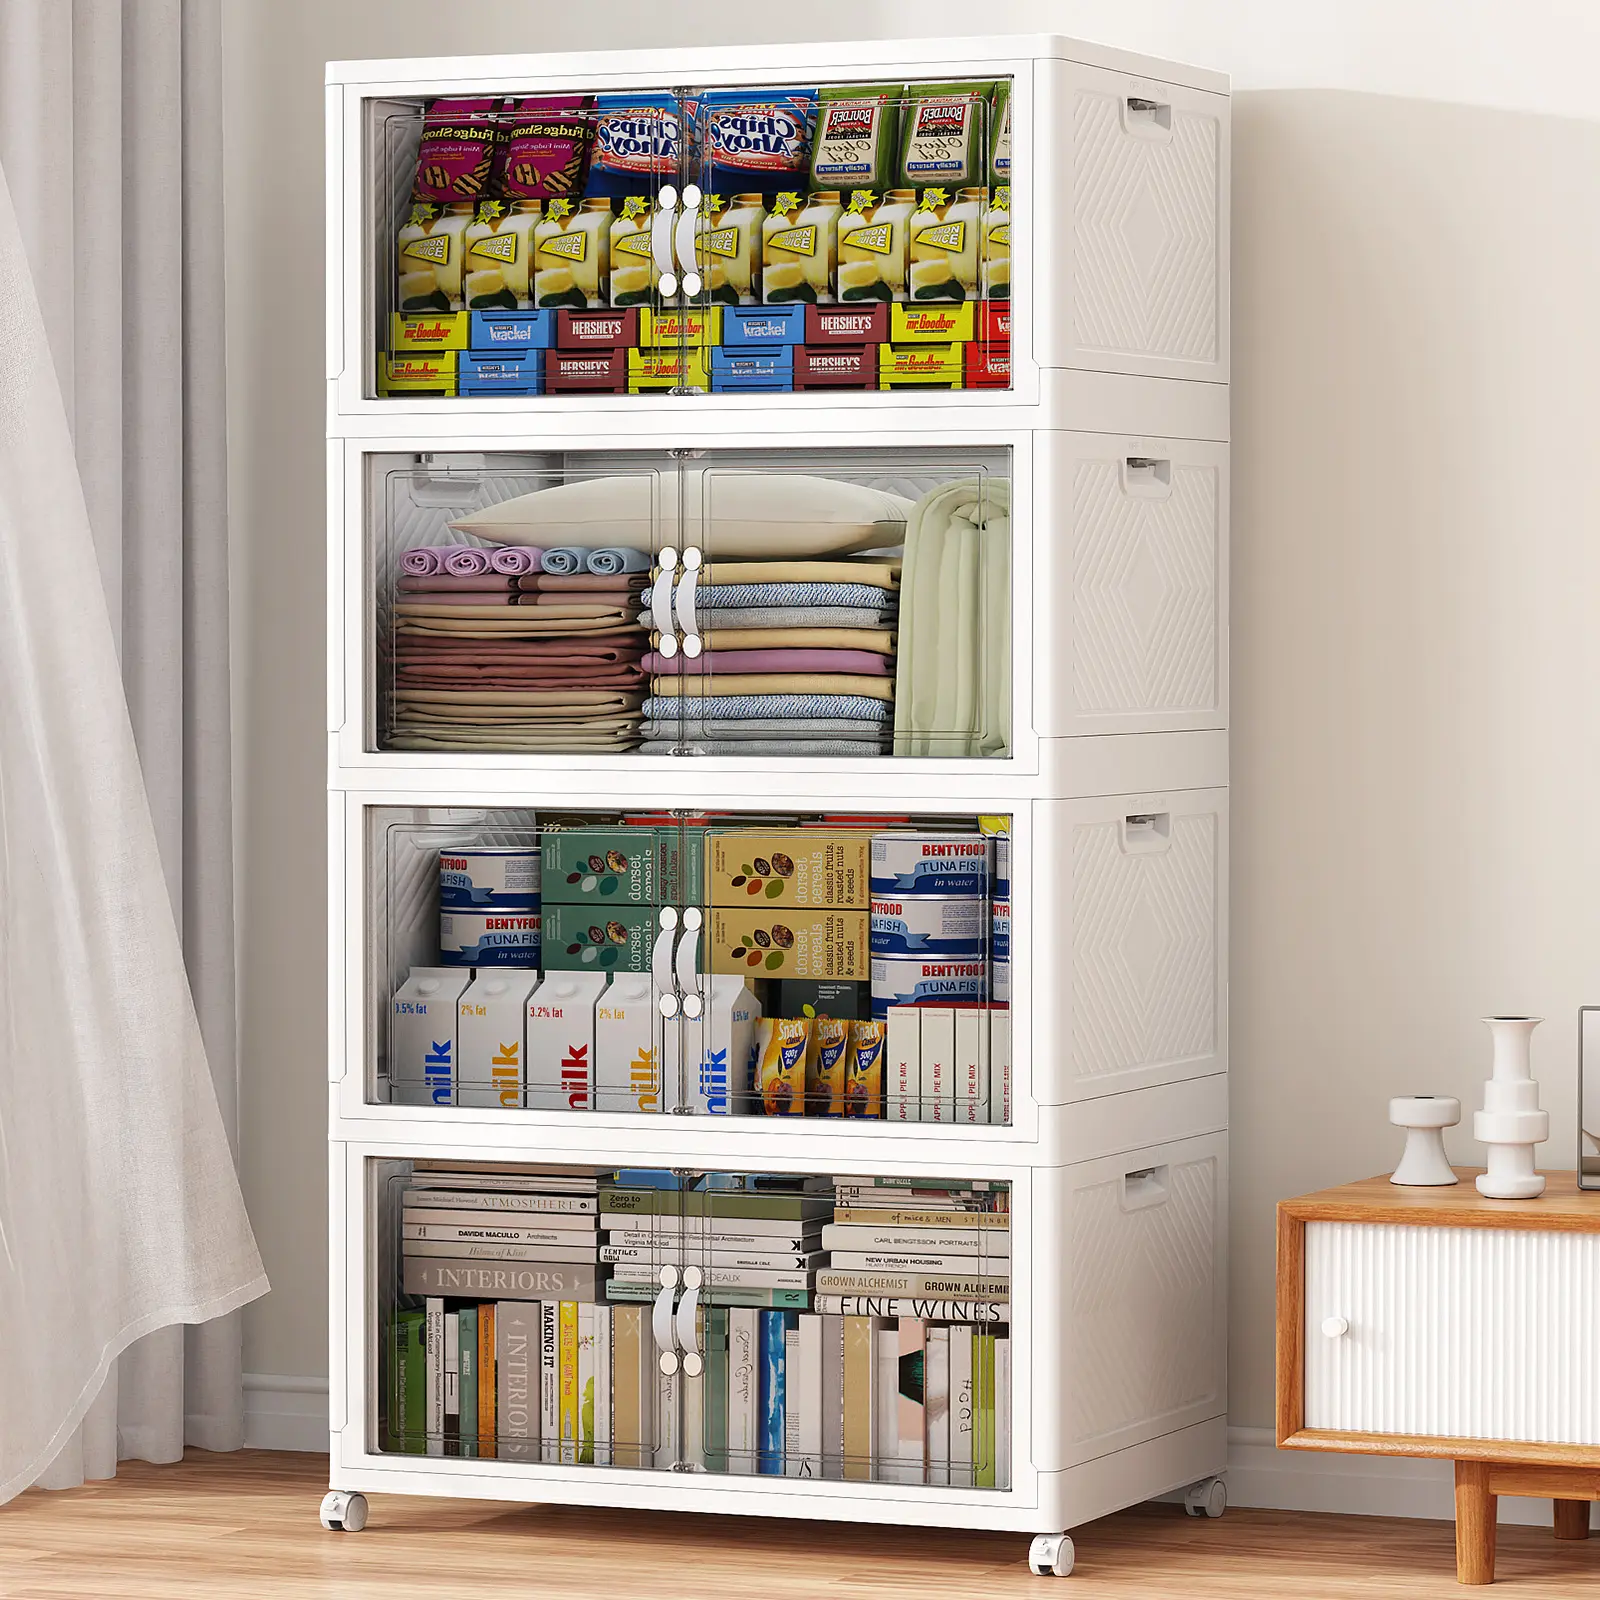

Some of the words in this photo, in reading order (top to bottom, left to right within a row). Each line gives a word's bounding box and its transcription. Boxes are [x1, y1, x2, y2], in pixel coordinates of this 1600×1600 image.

[856, 235, 887, 247] JUICE
[929, 233, 959, 246] JUICE
[552, 243, 581, 255] JUICE
[572, 321, 622, 335] HERSHEY'S
[743, 320, 786, 337] krackel
[820, 316, 872, 331] HERSHEY'S
[906, 320, 919, 330] mr.
[919, 313, 956, 329] Goodbar
[416, 322, 451, 339] Goodbar
[489, 325, 532, 341] krackel
[825, 842, 835, 872] fruits,
[836, 845, 844, 869] nuts
[919, 861, 957, 873] TUNA
[628, 854, 642, 901] dorset
[795, 857, 808, 904] dorset
[809, 852, 823, 904] cereals
[846, 868, 855, 895] seeds
[934, 878, 945, 887] in
[947, 879, 975, 887] water
[825, 873, 834, 904] classic
[835, 871, 844, 904] roasted
[485, 917, 541, 930] BENTYFOO
[825, 914, 835, 944] fruits,
[836, 917, 844, 941] nuts
[879, 920, 900, 932] FISH
[484, 935, 520, 946] TUNA
[521, 934, 541, 945] FIS
[497, 951, 508, 959] in
[510, 951, 537, 959] water
[628, 925, 642, 972] dorset
[795, 929, 808, 976] dorset
[809, 923, 823, 976] cereals
[846, 940, 855, 967] seeds
[825, 945, 834, 976] classic
[835, 943, 844, 976] roasted
[919, 981, 957, 993] TUNA
[415, 1003, 427, 1015] fat
[461, 1004, 474, 1016] 2%
[475, 1005, 487, 1016] fat
[529, 1006, 550, 1018] 3.2%
[552, 1007, 563, 1018] fat
[599, 1008, 612, 1019] 2%
[613, 1008, 625, 1020] fat
[778, 1020, 805, 1040] Snack
[818, 1020, 844, 1041] Snack
[854, 1021, 880, 1042] Snack
[933, 1063, 941, 1079] MIX
[968, 1064, 976, 1079] MIX
[933, 1080, 941, 1093] PIE
[968, 1081, 976, 1094] PIE
[480, 1197, 577, 1210] ATMOSPHERE
[609, 1194, 630, 1202] Zero
[631, 1195, 641, 1203] to
[609, 1201, 636, 1209] Coder
[891, 1212, 901, 1224] of
[904, 1214, 925, 1222] mice
[458, 1230, 485, 1238] DAVIDE
[485, 1230, 520, 1239] MACULLO
[526, 1233, 558, 1241] Architects
[623, 1231, 640, 1239] Detail
[624, 1239, 646, 1247] Virginia
[939, 1239, 978, 1247] PORTRAITS
[882, 1257, 909, 1265] URBAN
[436, 1268, 564, 1291] INTERIORS
[820, 1275, 856, 1287] GROWN
[857, 1277, 908, 1289] ALCHEMIST
[924, 1281, 961, 1292] GROWN
[840, 1296, 900, 1317] FINE
[912, 1299, 1001, 1322] WINES
[434, 1311, 442, 1327] Detail
[543, 1305, 555, 1355] MAKING
[543, 1356, 554, 1368] IT
[507, 1333, 528, 1453] INTERIORS
